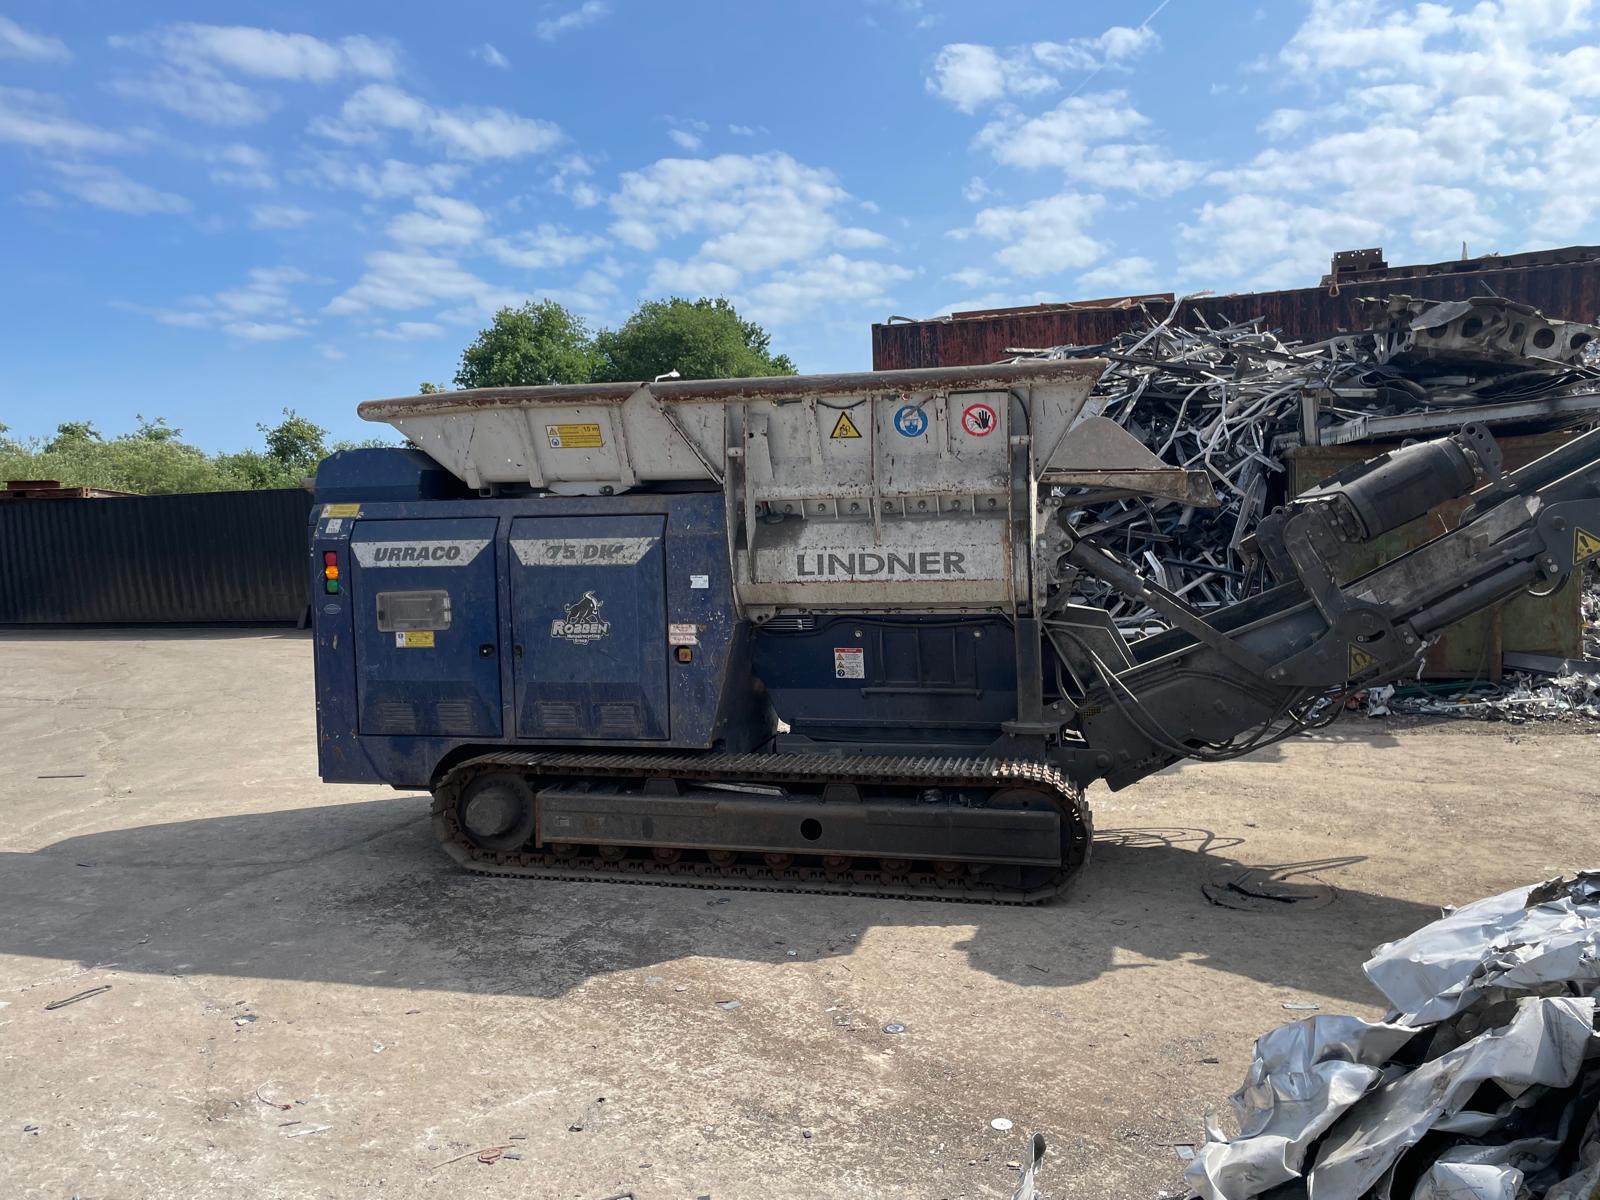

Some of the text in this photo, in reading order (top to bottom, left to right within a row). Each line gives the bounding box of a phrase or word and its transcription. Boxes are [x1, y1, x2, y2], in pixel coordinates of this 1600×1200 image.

[373, 545, 461, 562] URRACO
[545, 545, 577, 560] 75
[796, 551, 967, 577] LINDNER
[552, 621, 609, 636] ROBBEN
